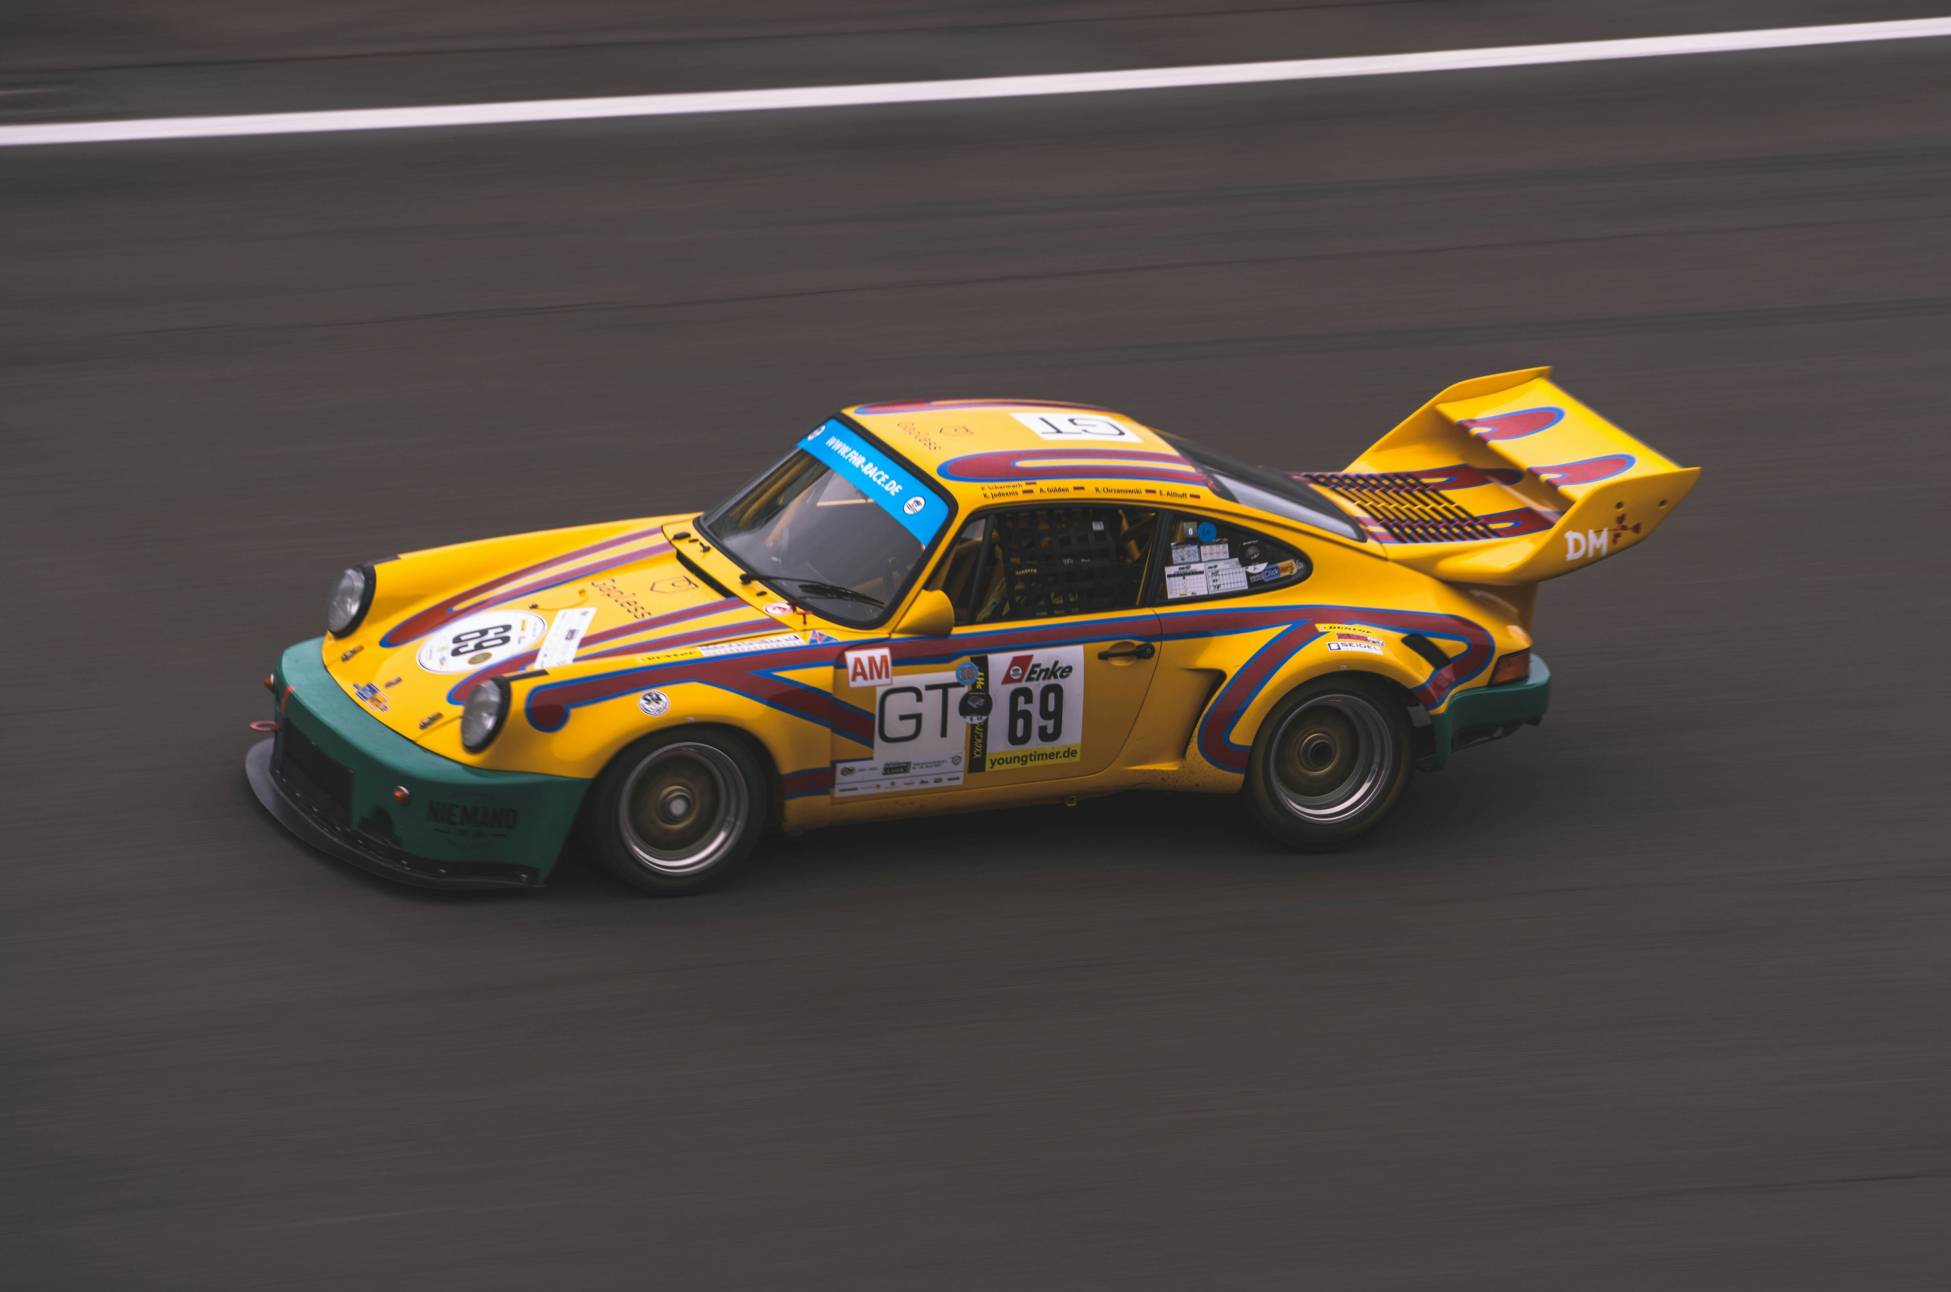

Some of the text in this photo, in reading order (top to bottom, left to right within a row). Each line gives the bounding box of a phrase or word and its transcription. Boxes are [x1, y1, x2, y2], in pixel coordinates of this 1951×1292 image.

[1565, 528, 1609, 561] DM
[450, 624, 513, 657] 69
[850, 653, 890, 683] AM
[1025, 660, 1073, 684] Enke
[878, 682, 965, 744] GT
[1007, 683, 1064, 747] 69
[989, 747, 1078, 769] youngtimer.de
